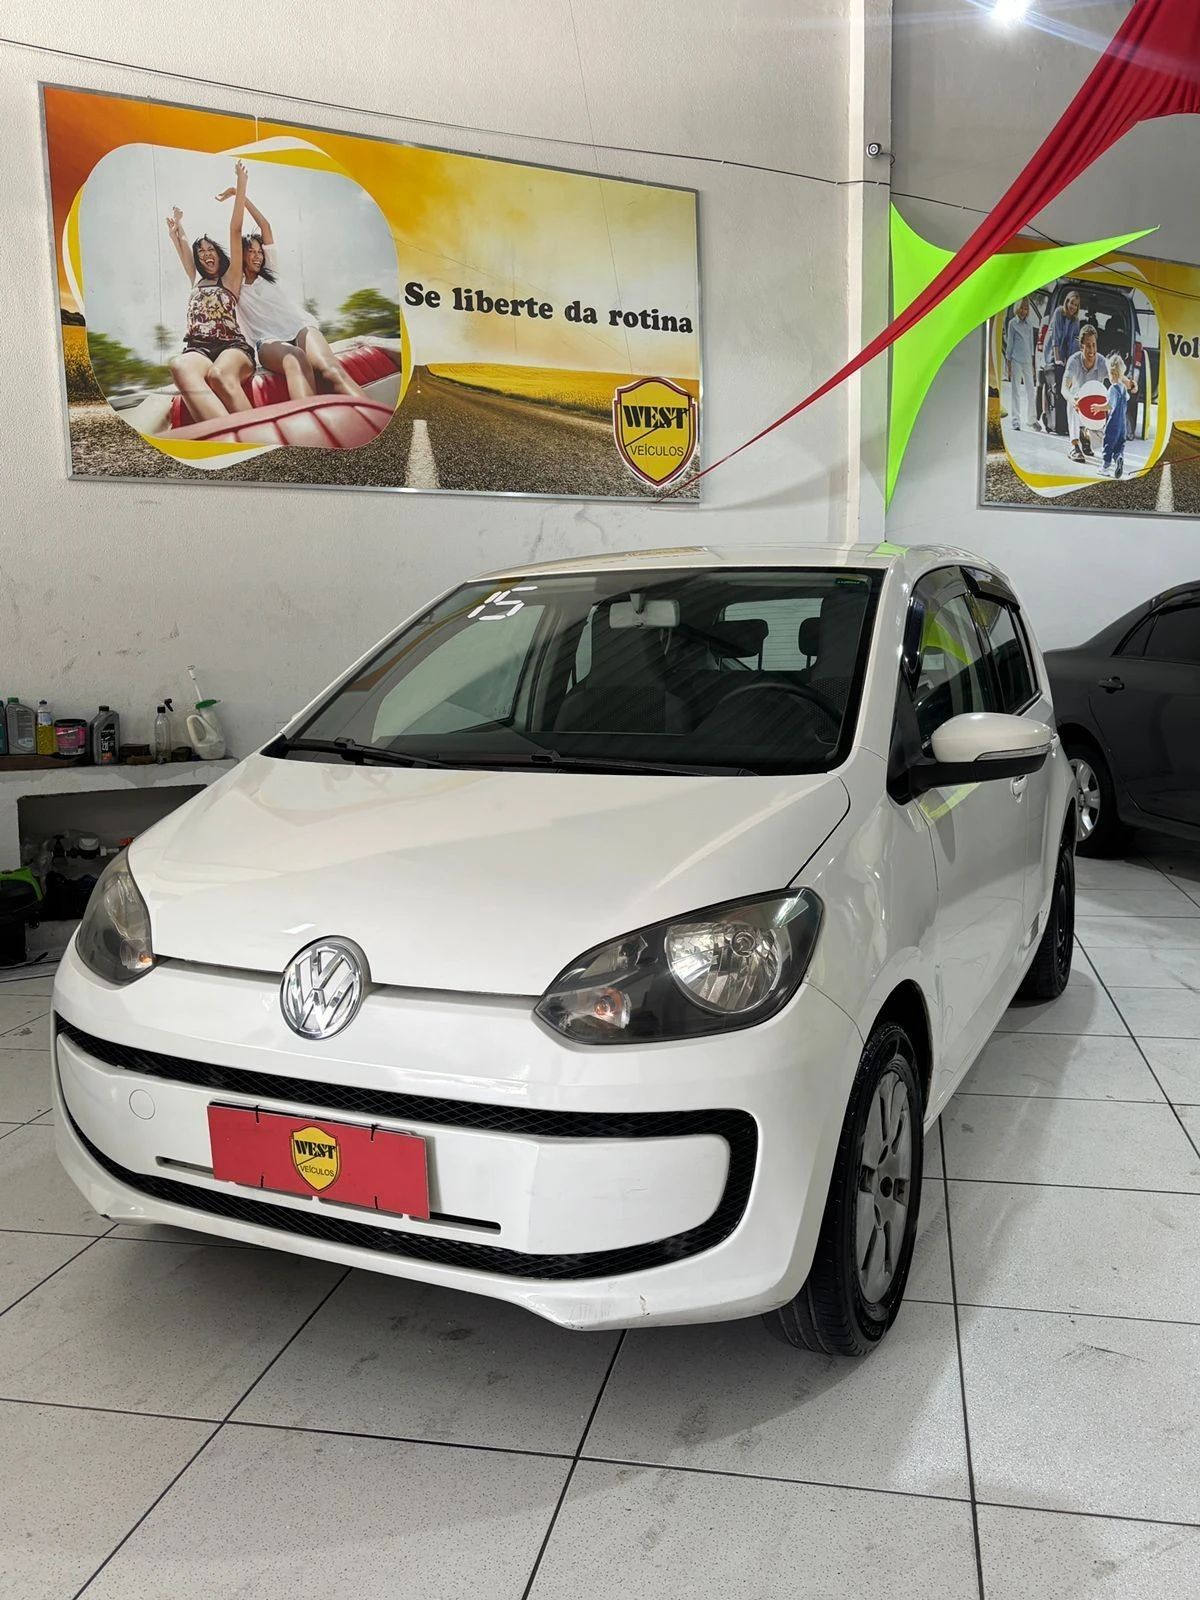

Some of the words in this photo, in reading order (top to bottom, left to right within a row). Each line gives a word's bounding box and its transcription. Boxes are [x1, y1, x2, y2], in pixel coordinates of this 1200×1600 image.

[404, 282, 441, 308] Se
[452, 287, 554, 320] liberte
[564, 300, 598, 324] da
[609, 308, 693, 334] rotina
[1167, 333, 1199, 358] Vol
[622, 405, 689, 429] WEST
[630, 444, 684, 457] VEÍCULOS
[467, 586, 539, 621] 15
[295, 1139, 337, 1159] WEST
[300, 1164, 335, 1177] VEÍCULOS
